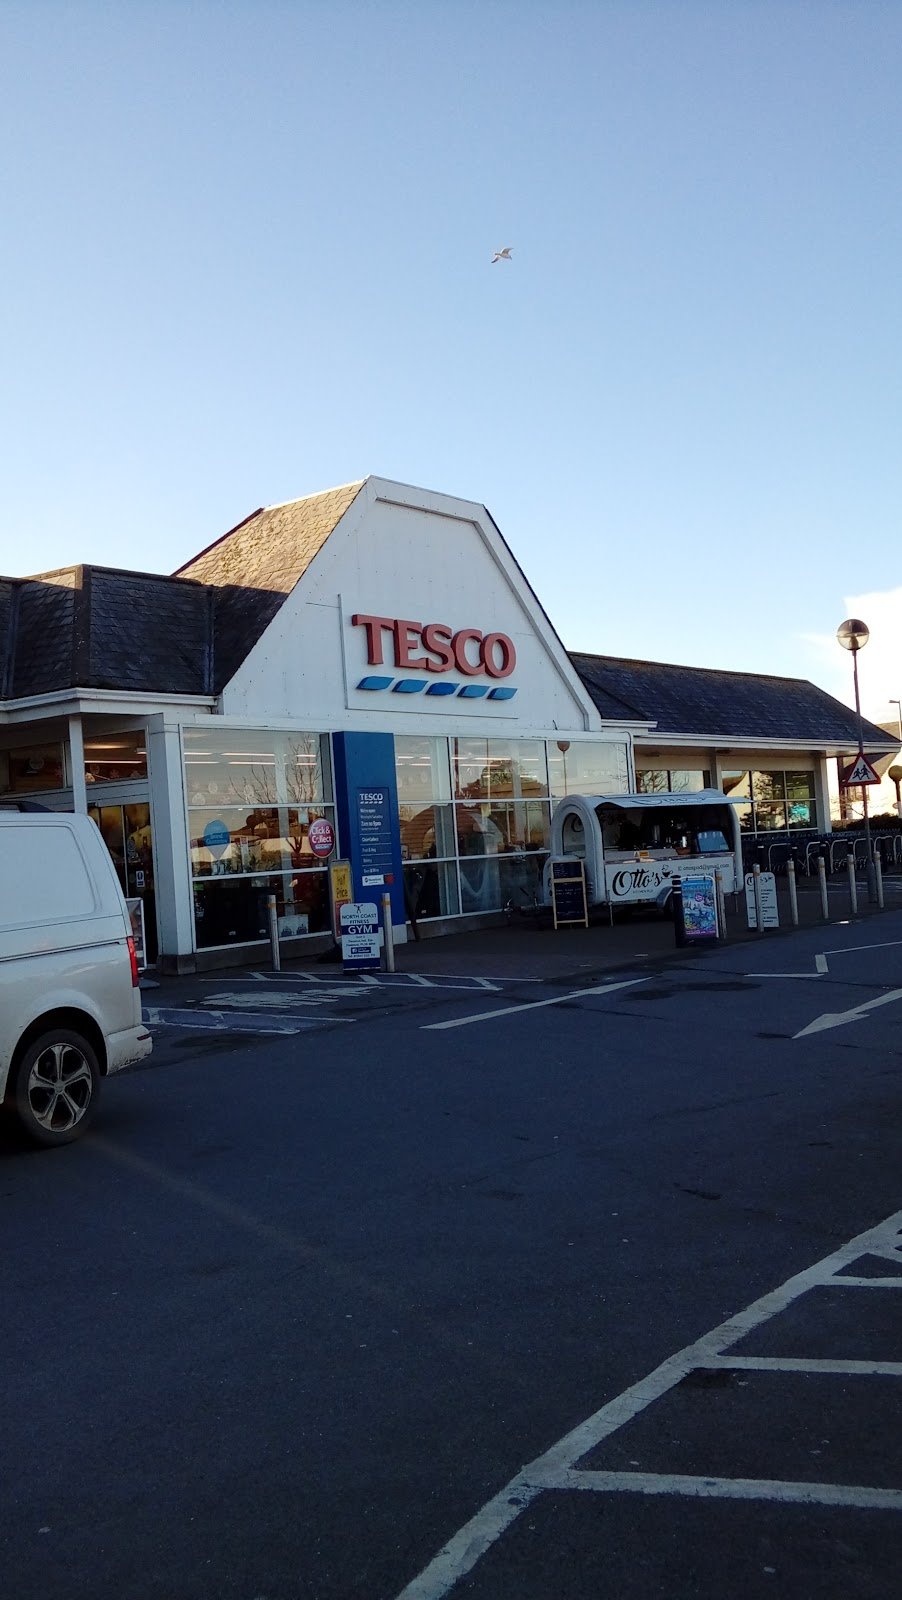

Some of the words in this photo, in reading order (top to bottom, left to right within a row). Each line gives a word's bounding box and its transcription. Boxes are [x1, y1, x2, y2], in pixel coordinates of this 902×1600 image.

[351, 614, 516, 678] TESCO
[360, 793, 383, 801] TESCO
[612, 867, 660, 896] Otto's
[348, 924, 373, 935] GYM
